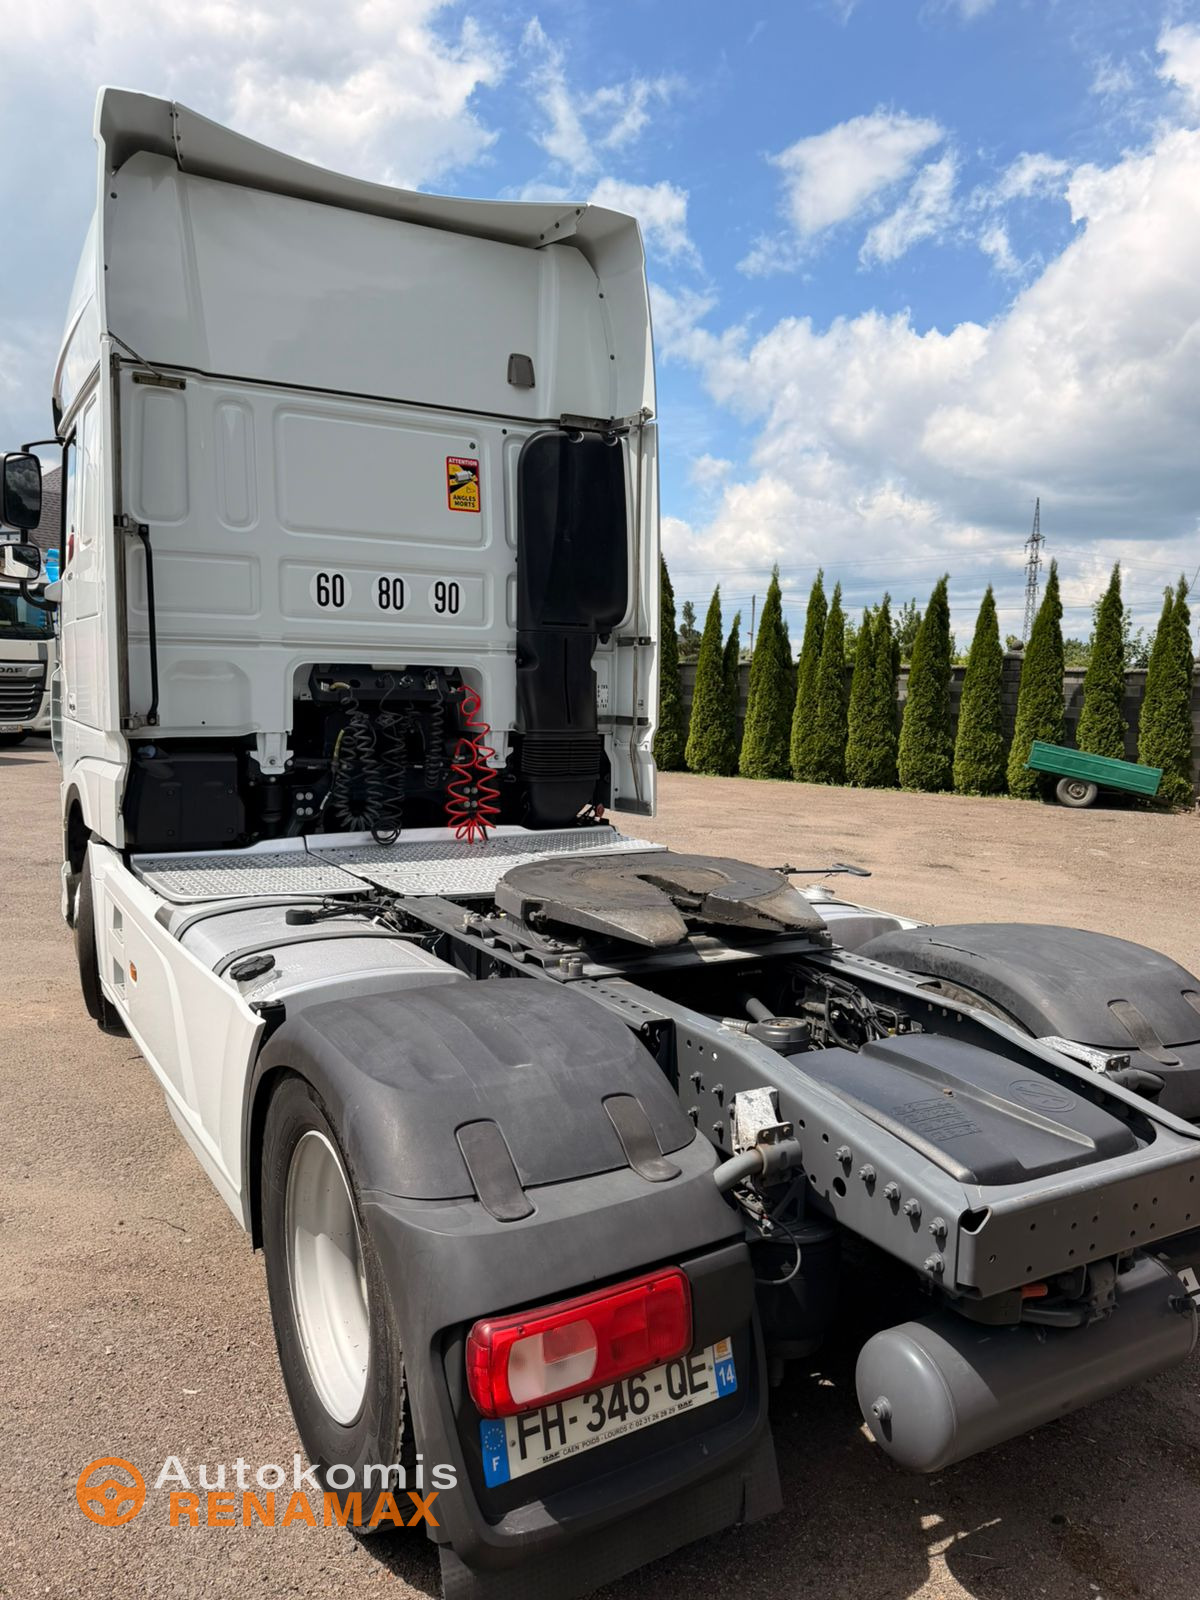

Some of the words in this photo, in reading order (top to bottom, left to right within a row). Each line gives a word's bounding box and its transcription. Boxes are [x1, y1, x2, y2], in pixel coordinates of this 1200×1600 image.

[448, 458, 477, 466] ATTENTION
[453, 494, 476, 502] ANGLES
[316, 572, 345, 608] 60
[378, 576, 404, 611] 80
[434, 580, 459, 614] 90
[719, 1364, 734, 1386] 14
[542, 1451, 560, 1463] DAF
[562, 1444, 580, 1456] CAEN
[582, 1434, 600, 1449] POIDS
[677, 1400, 694, 1411] DAF
[492, 1455, 500, 1472] F
